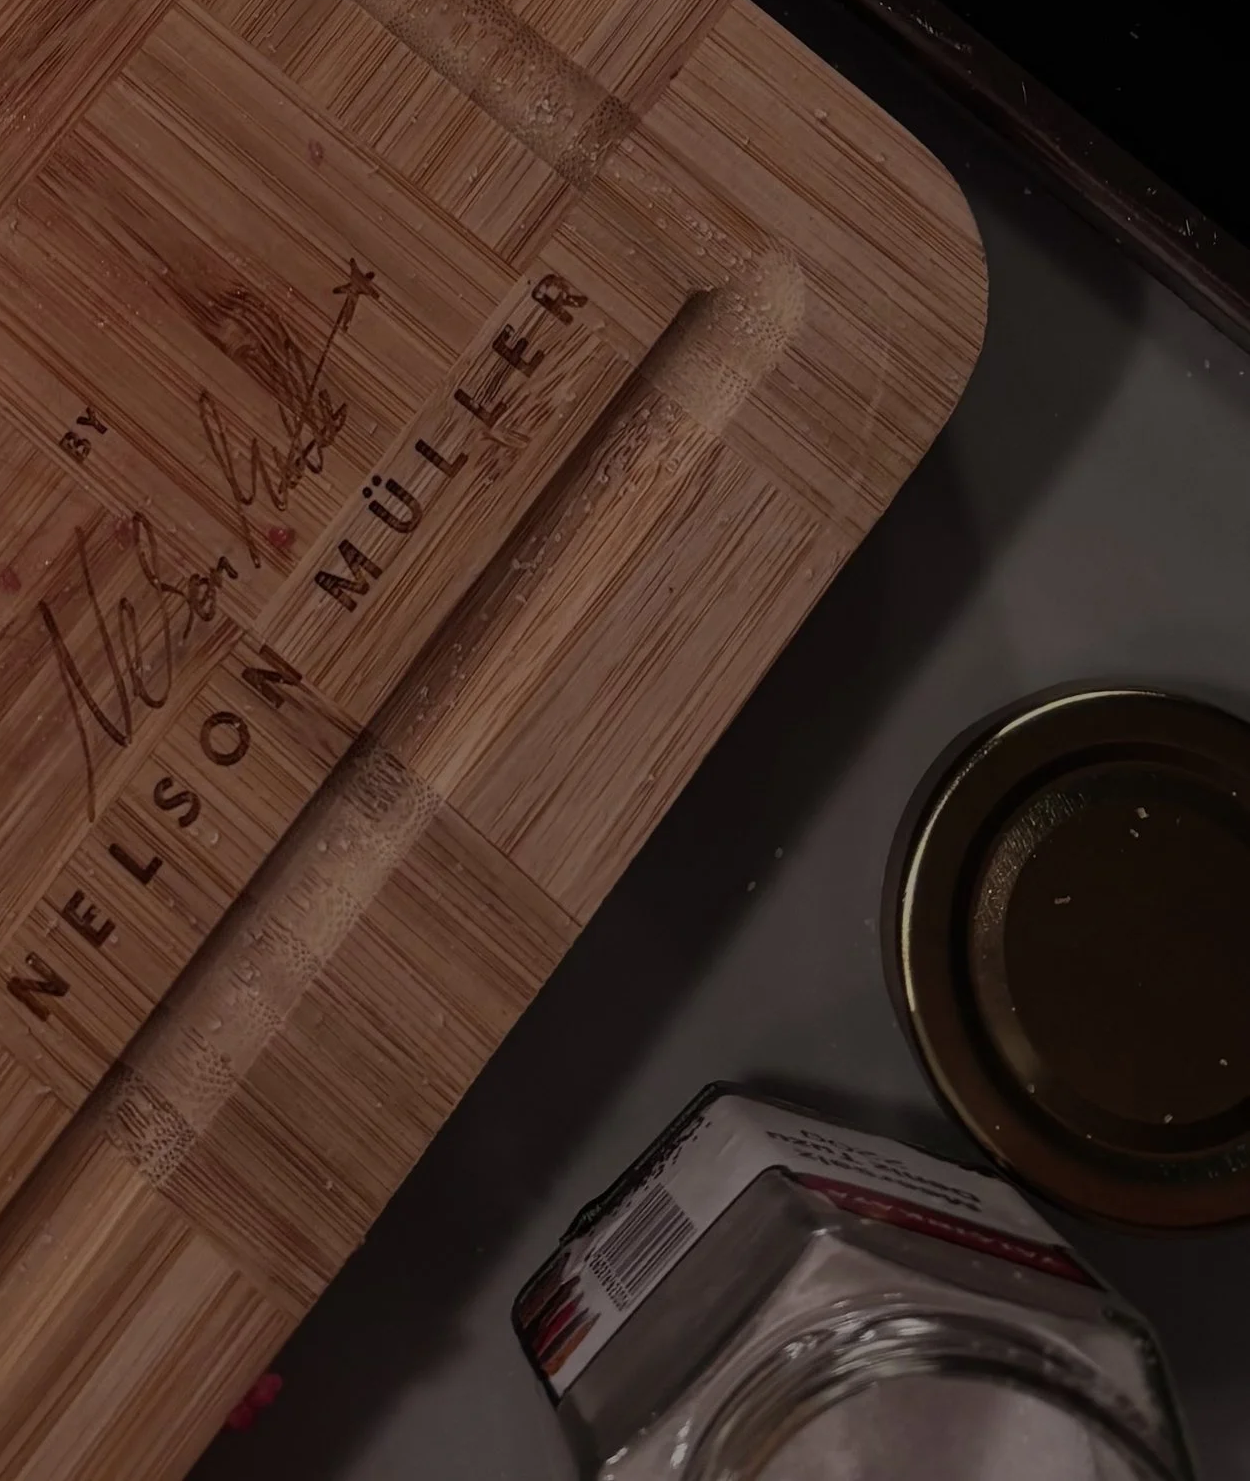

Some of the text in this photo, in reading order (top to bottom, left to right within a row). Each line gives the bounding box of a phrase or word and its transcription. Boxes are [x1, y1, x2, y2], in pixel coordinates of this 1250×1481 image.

[58, 406, 108, 464] BY
[5, 271, 590, 1023] NELSON MÜLLER
